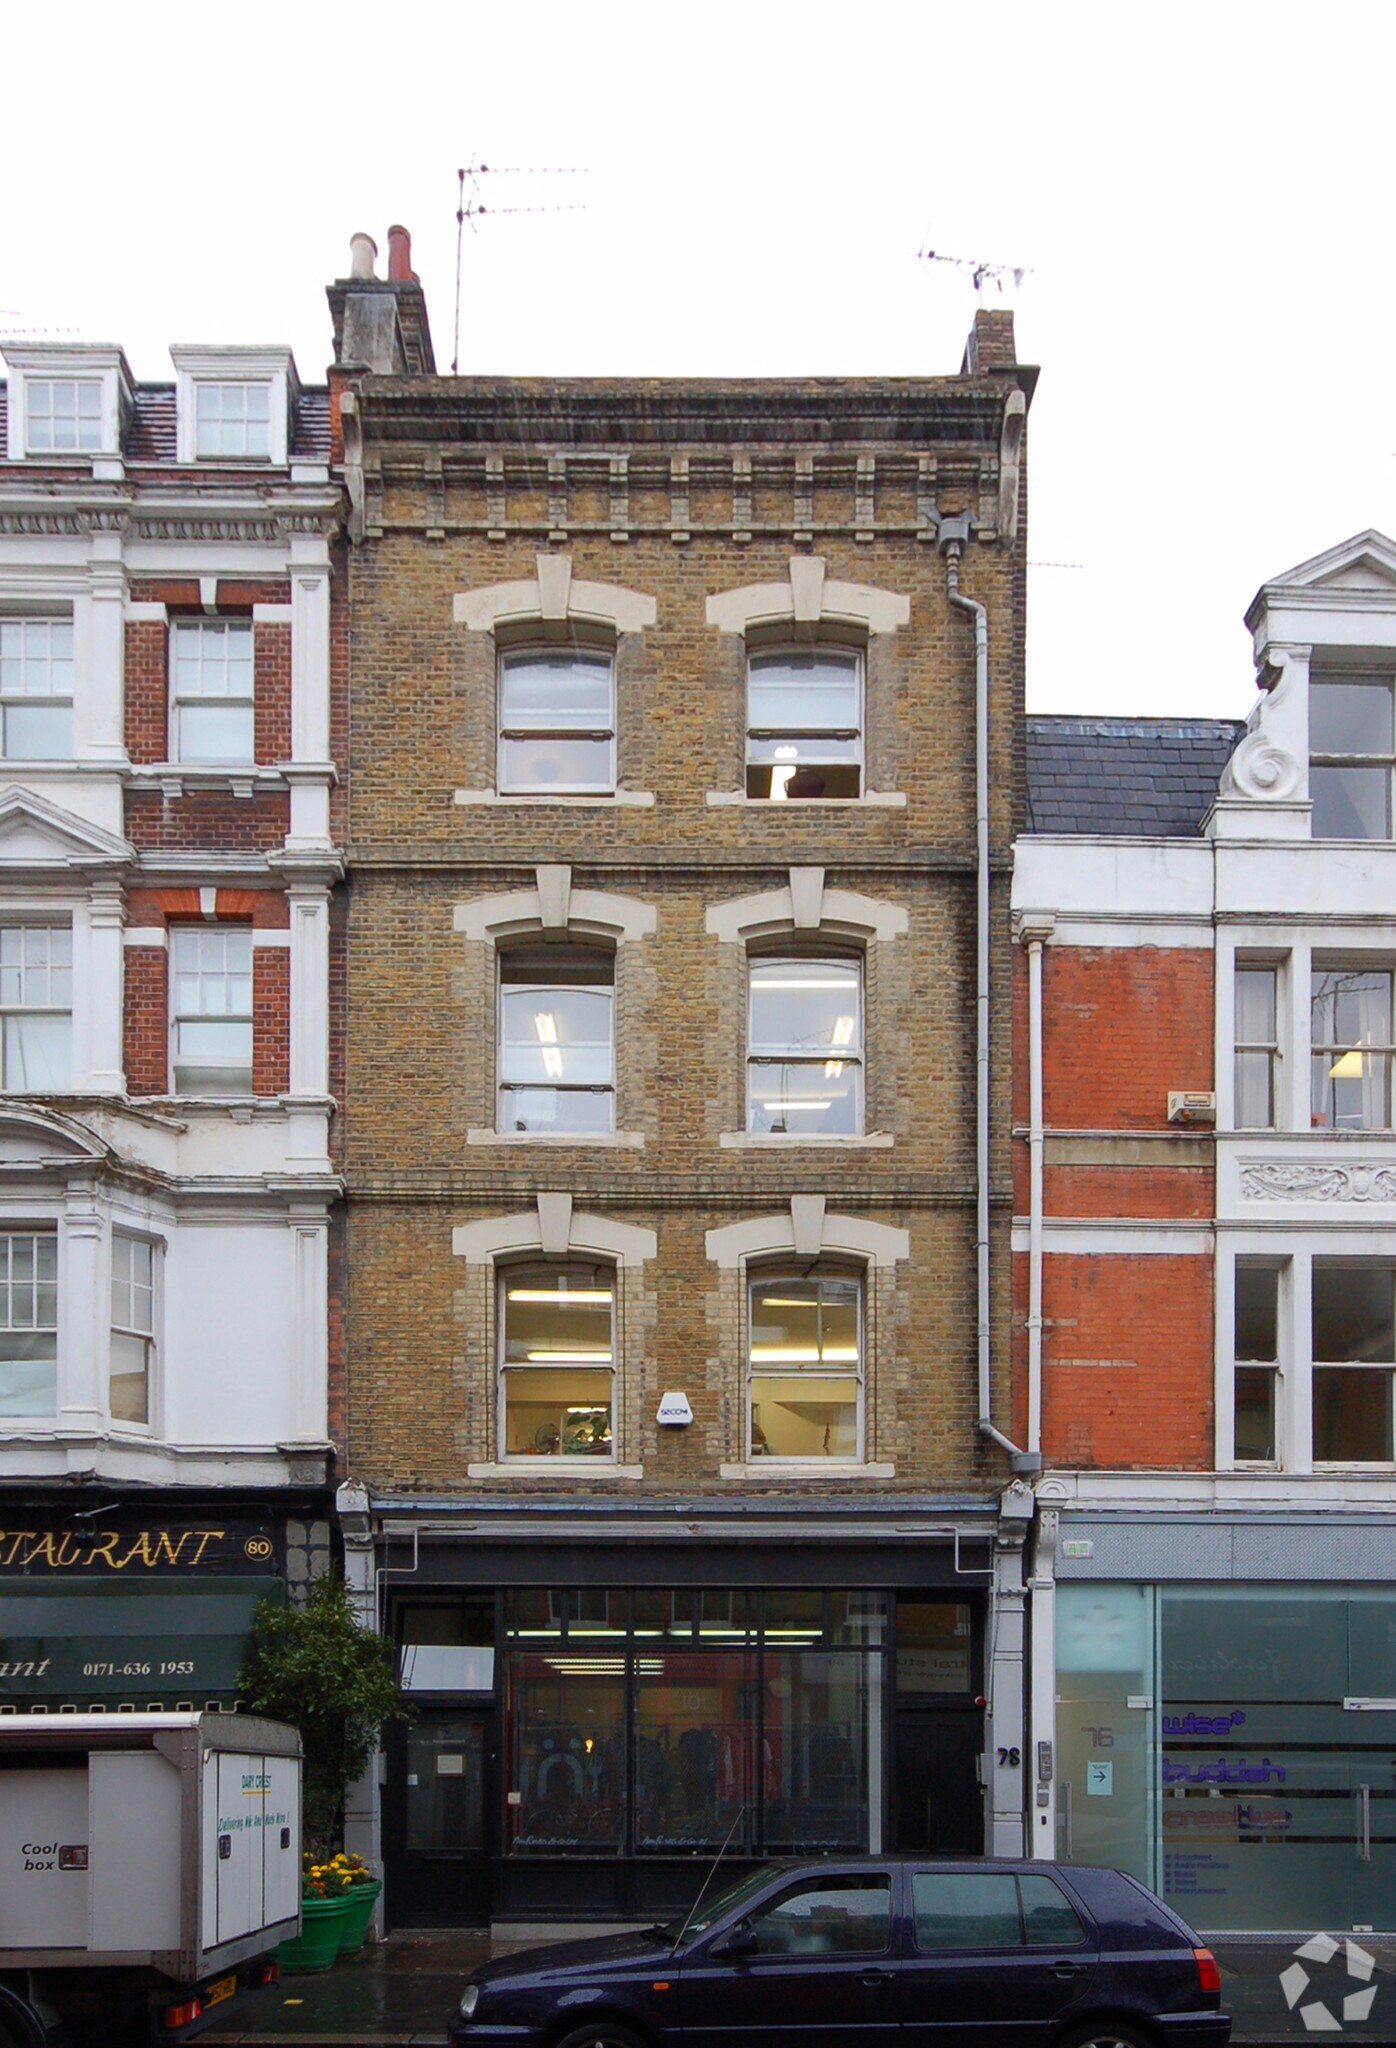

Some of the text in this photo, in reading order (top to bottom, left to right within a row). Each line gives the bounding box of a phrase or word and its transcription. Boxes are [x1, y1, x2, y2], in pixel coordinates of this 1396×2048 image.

[0, 1531, 225, 1568] TAURANT
[247, 1541, 269, 1555] 80
[83, 1663, 150, 1676] 0171-636
[159, 1661, 194, 1675] 1953
[1081, 1727, 1114, 1748] 76
[997, 1747, 1020, 1766] 78
[1162, 1758, 1286, 1783] buddah
[21, 1843, 58, 1856] Cool
[24, 1858, 54, 1871] box
